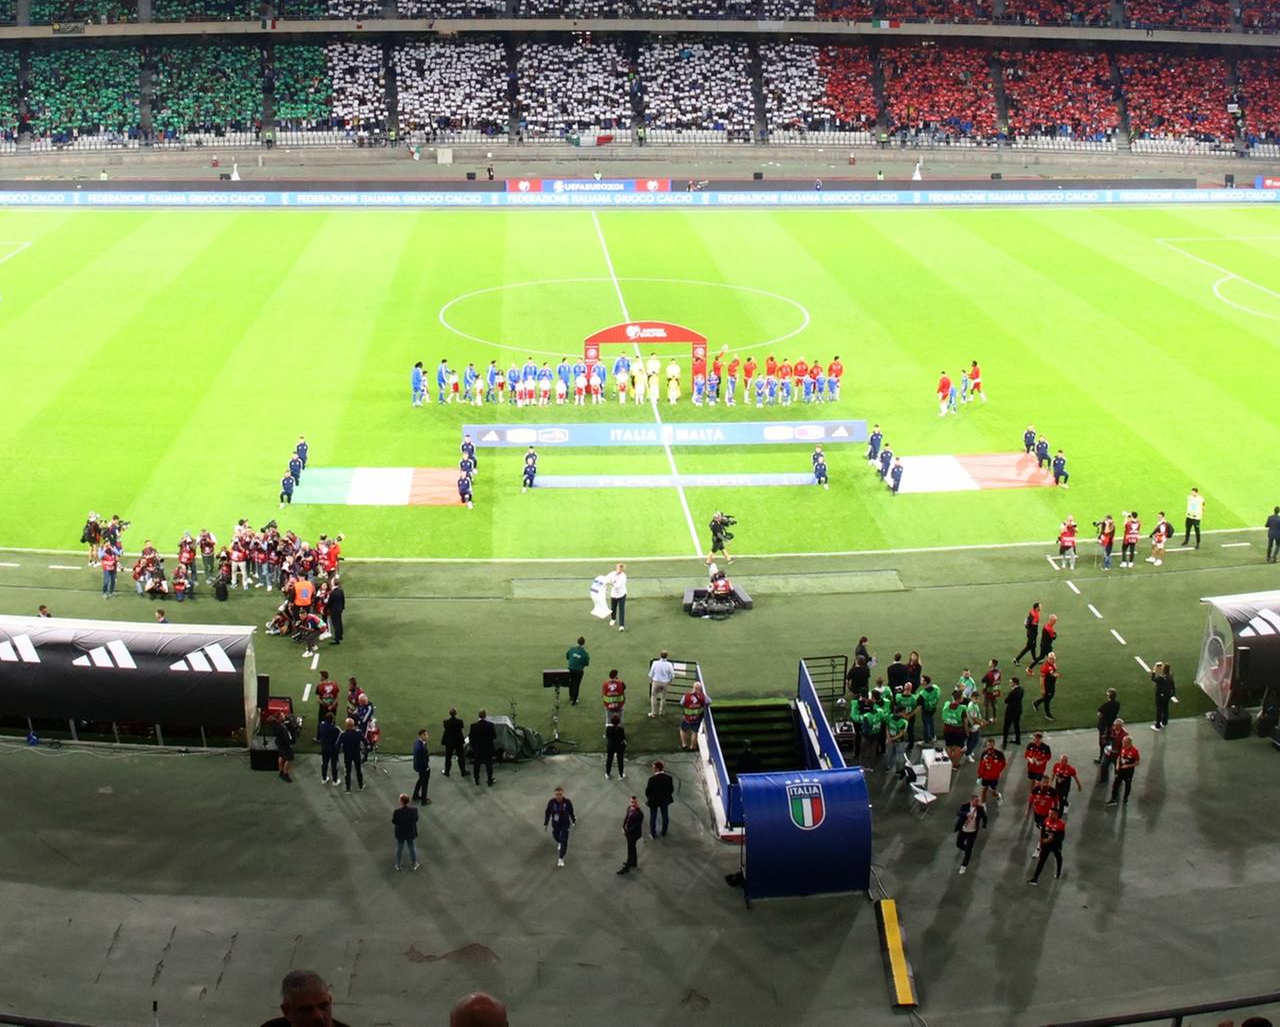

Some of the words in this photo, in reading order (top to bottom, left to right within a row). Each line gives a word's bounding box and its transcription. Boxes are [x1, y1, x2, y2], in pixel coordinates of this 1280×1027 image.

[230, 194, 266, 204] CALCIO
[297, 195, 358, 204] FEDERAZIONE
[446, 195, 482, 204] CALCIO
[508, 194, 569, 204] FEDERAZIONE
[572, 194, 611, 204] ITALIANA
[657, 194, 693, 204] CALCIO
[864, 194, 897, 203] CALCIO
[610, 429, 657, 441] ITALIA
[675, 429, 725, 441] MALTA
[789, 786, 820, 796] ITALIA
